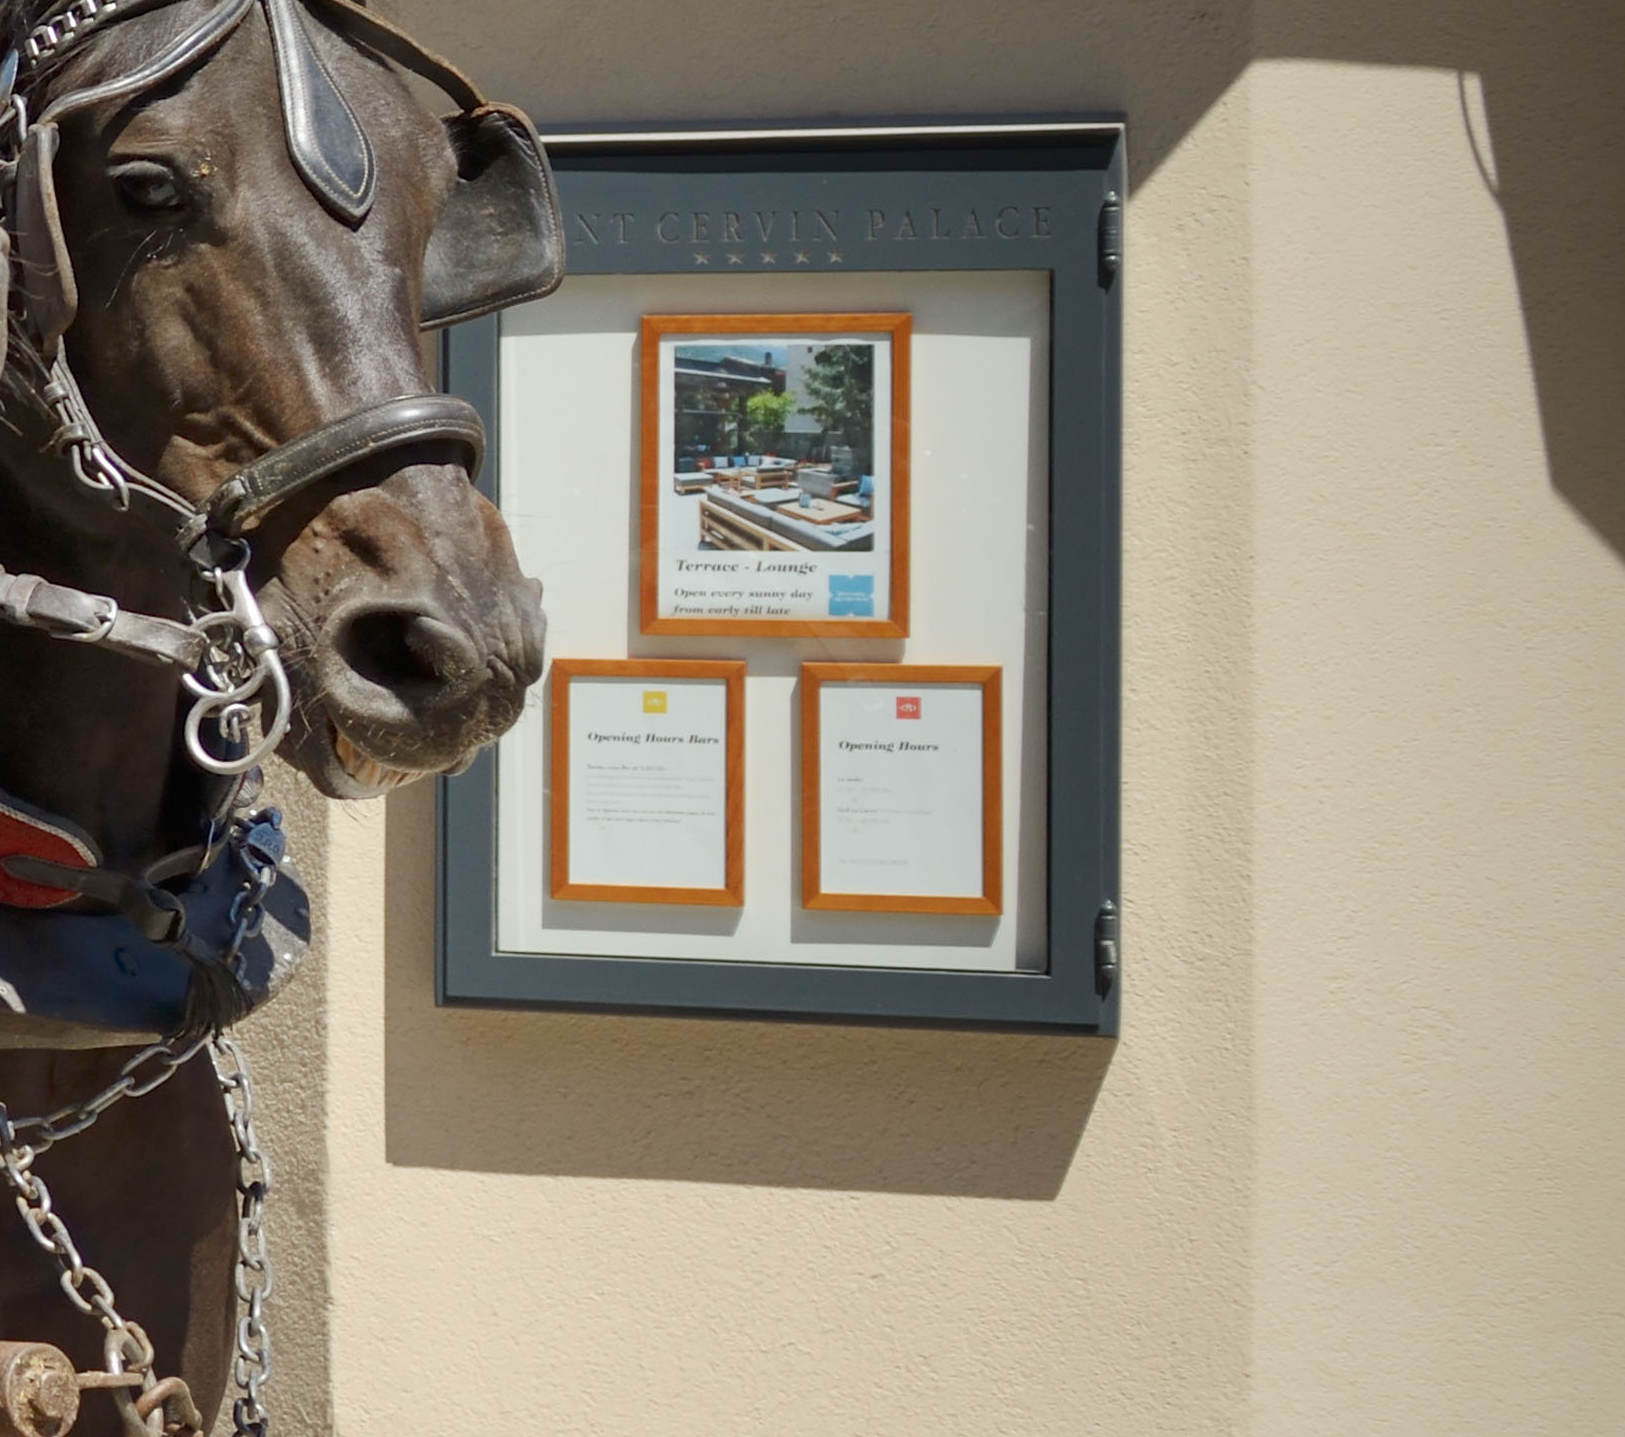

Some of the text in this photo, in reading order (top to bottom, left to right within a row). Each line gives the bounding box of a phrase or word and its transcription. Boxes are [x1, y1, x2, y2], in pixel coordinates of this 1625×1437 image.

[573, 205, 1054, 246] NT CERVIN PALACE
[675, 559, 740, 574] Terrace
[755, 560, 818, 575] Lounge
[673, 587, 814, 600] Open every sunny day
[672, 605, 704, 617] from
[586, 731, 721, 746] Opening Hours Bars
[838, 739, 940, 754] Opening Hours
